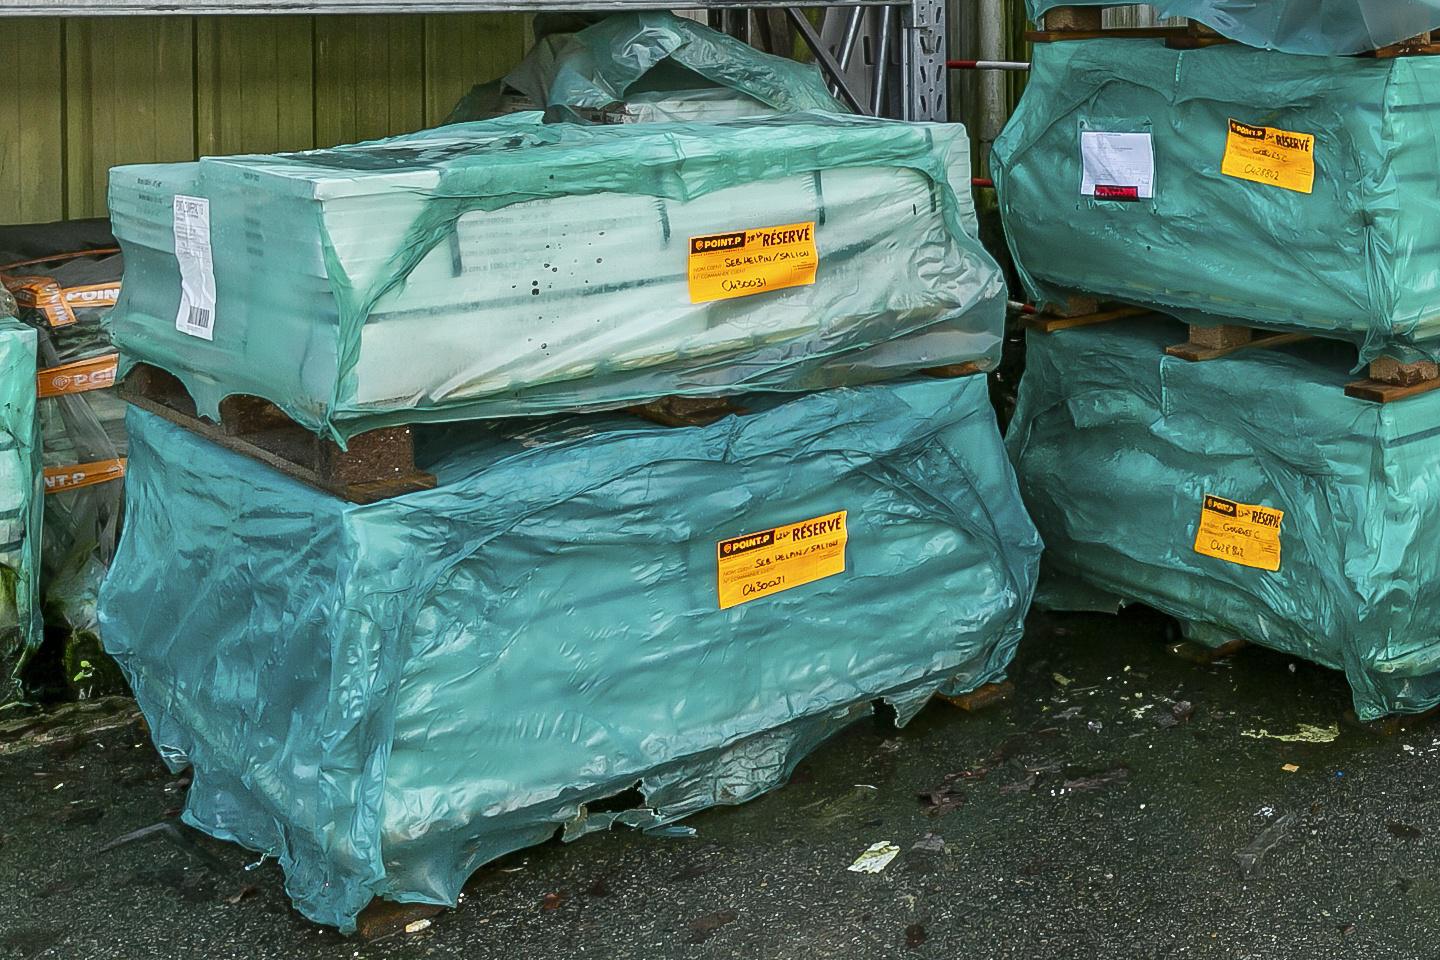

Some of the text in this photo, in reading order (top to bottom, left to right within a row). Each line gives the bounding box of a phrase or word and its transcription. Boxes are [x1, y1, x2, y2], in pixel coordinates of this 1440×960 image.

[1275, 133, 1310, 152] RÉSERVÉ
[704, 236, 742, 249] POINT.P
[762, 224, 810, 247] RÉSERVÉ
[732, 514, 842, 551] POINT.P RÉSERVÉ
